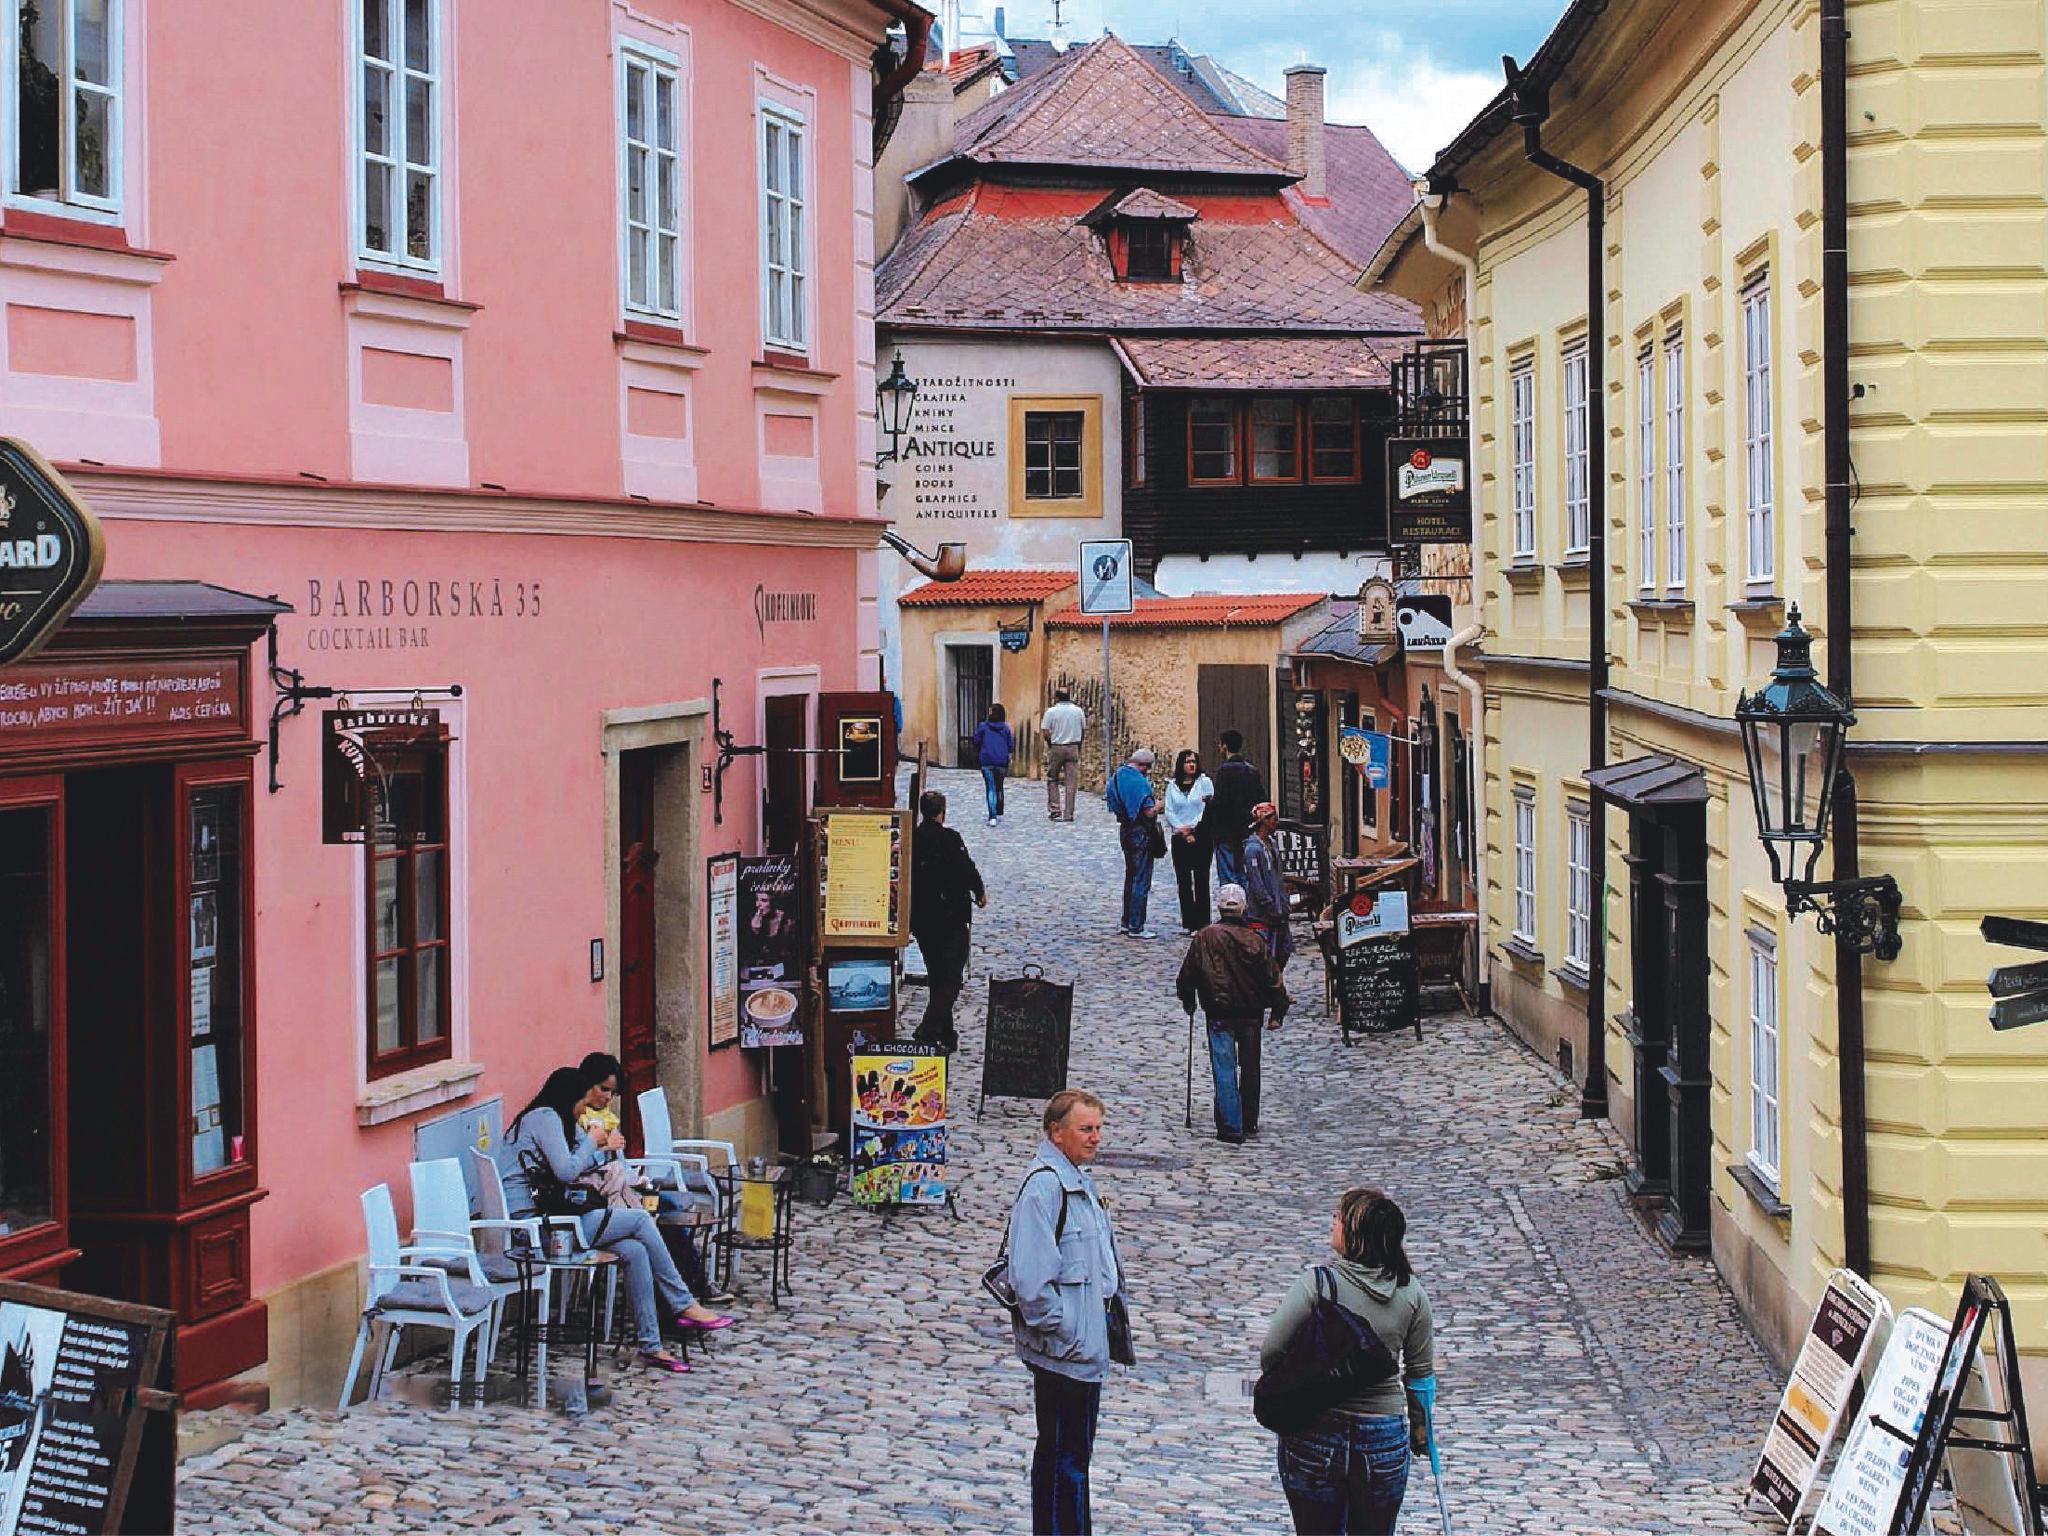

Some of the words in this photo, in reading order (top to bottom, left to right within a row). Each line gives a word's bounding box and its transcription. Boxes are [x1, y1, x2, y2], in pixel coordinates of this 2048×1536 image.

[915, 376, 1015, 387] STAROŽITNOSTI
[914, 393, 966, 402] GRAFIKA
[915, 409, 954, 417] KNIHY
[915, 424, 954, 432] MINCE
[915, 464, 953, 472] COINS
[915, 480, 953, 488] BOOKS
[915, 495, 977, 503] GRAPHICS
[916, 510, 997, 519] ANTIQUITIES
[1417, 516, 1447, 526] HOTEL
[516, 583, 541, 616] 35
[307, 628, 393, 650] COCKTAIL
[399, 627, 430, 648] BAR
[1407, 634, 1447, 646] LAVAZZA
